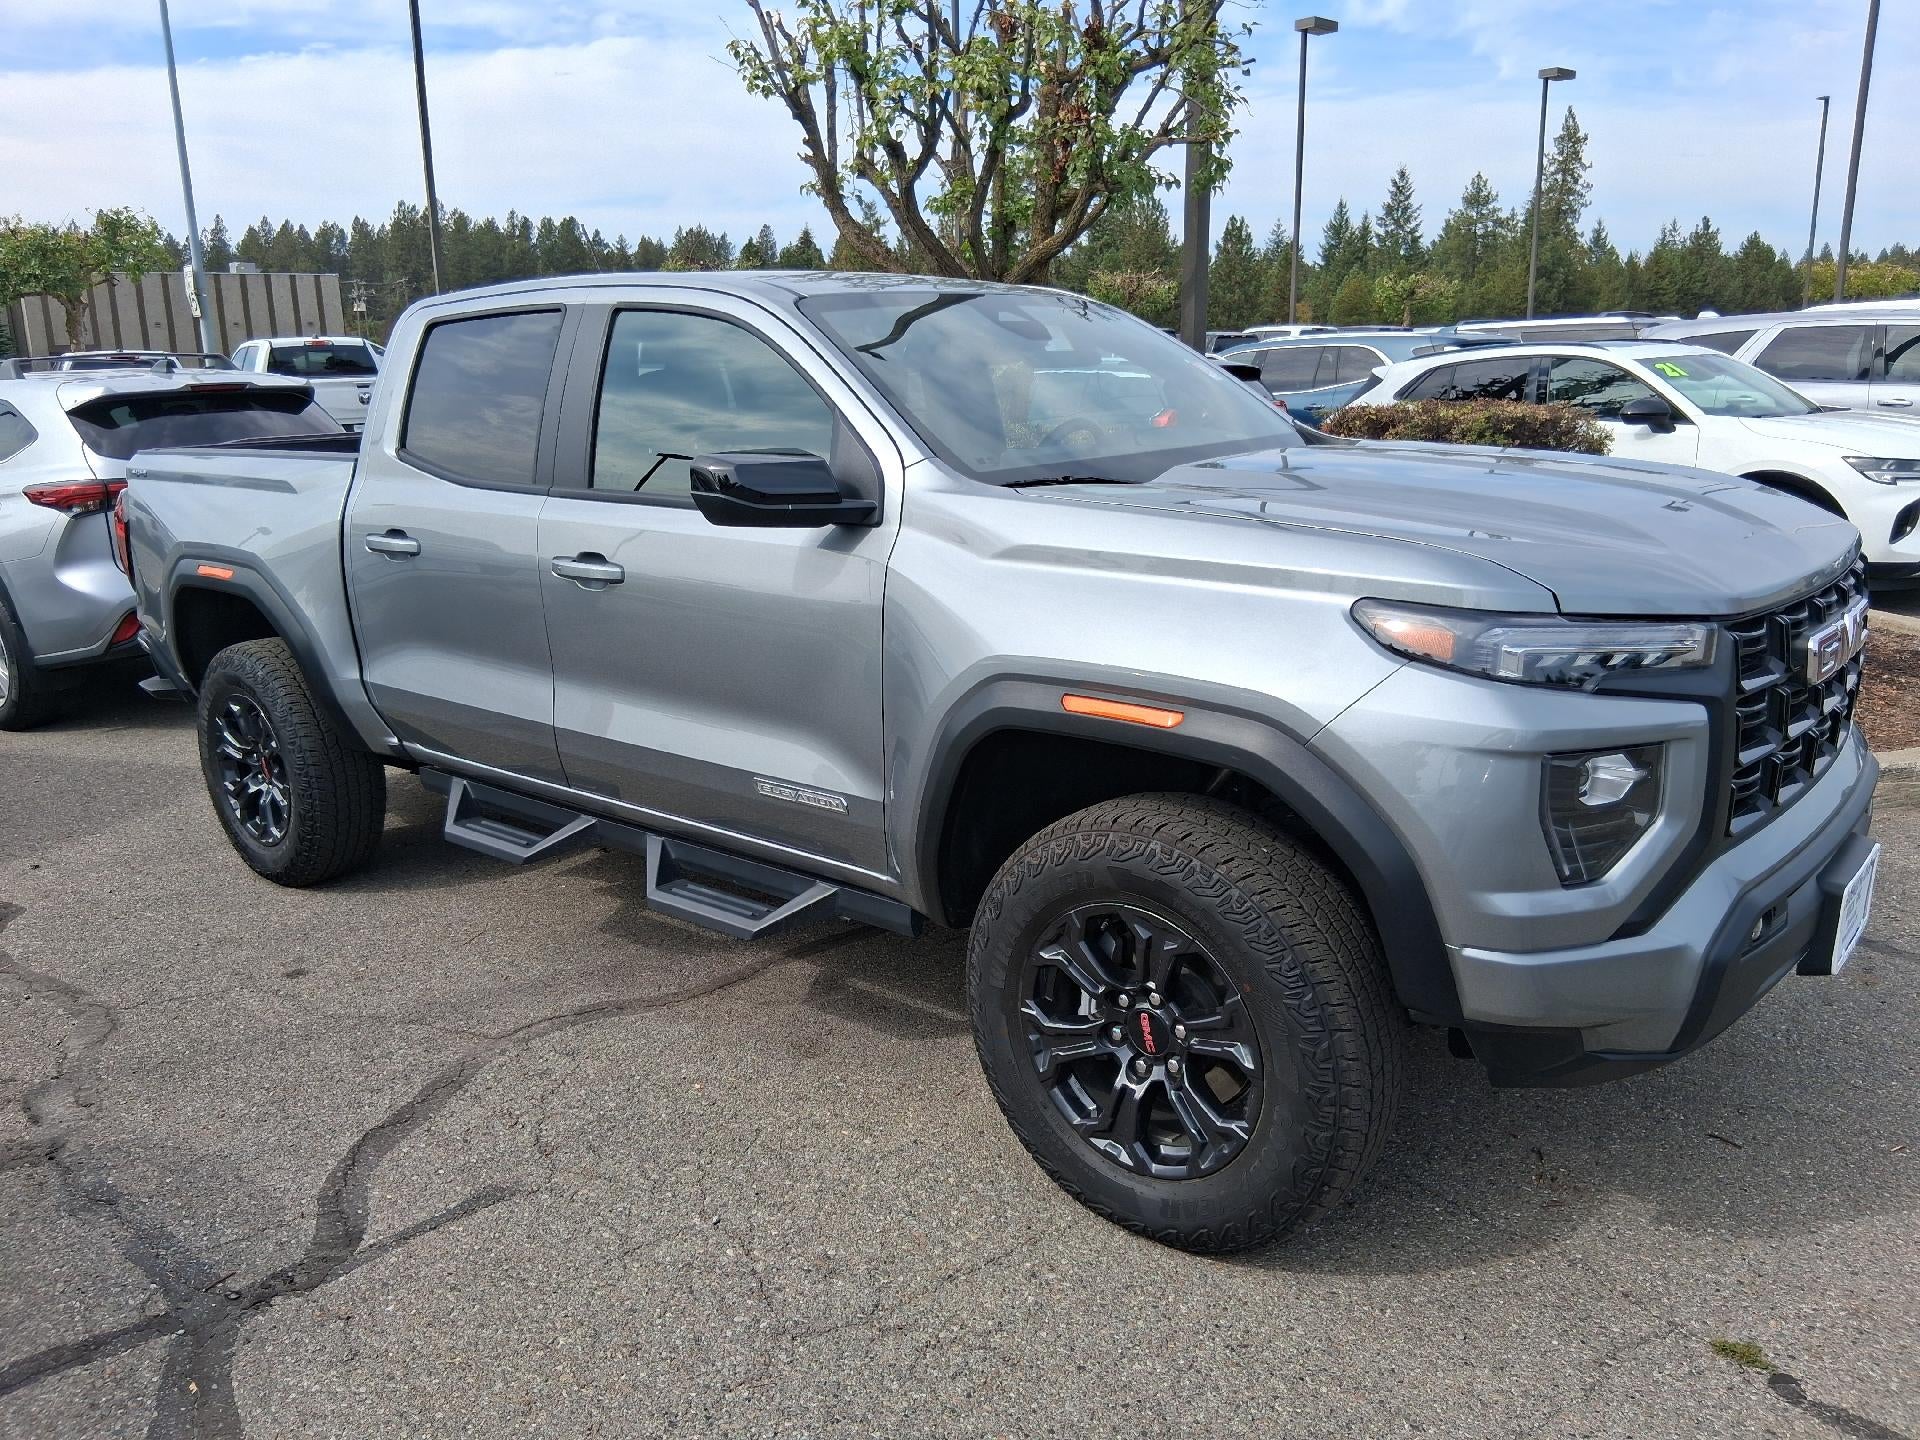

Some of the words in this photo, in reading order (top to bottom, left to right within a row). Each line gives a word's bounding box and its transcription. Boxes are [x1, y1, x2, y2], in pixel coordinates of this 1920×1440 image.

[1654, 362, 1689, 377] 21
[757, 781, 845, 812] ELEVATION
[1140, 1013, 1156, 1053] GMC
